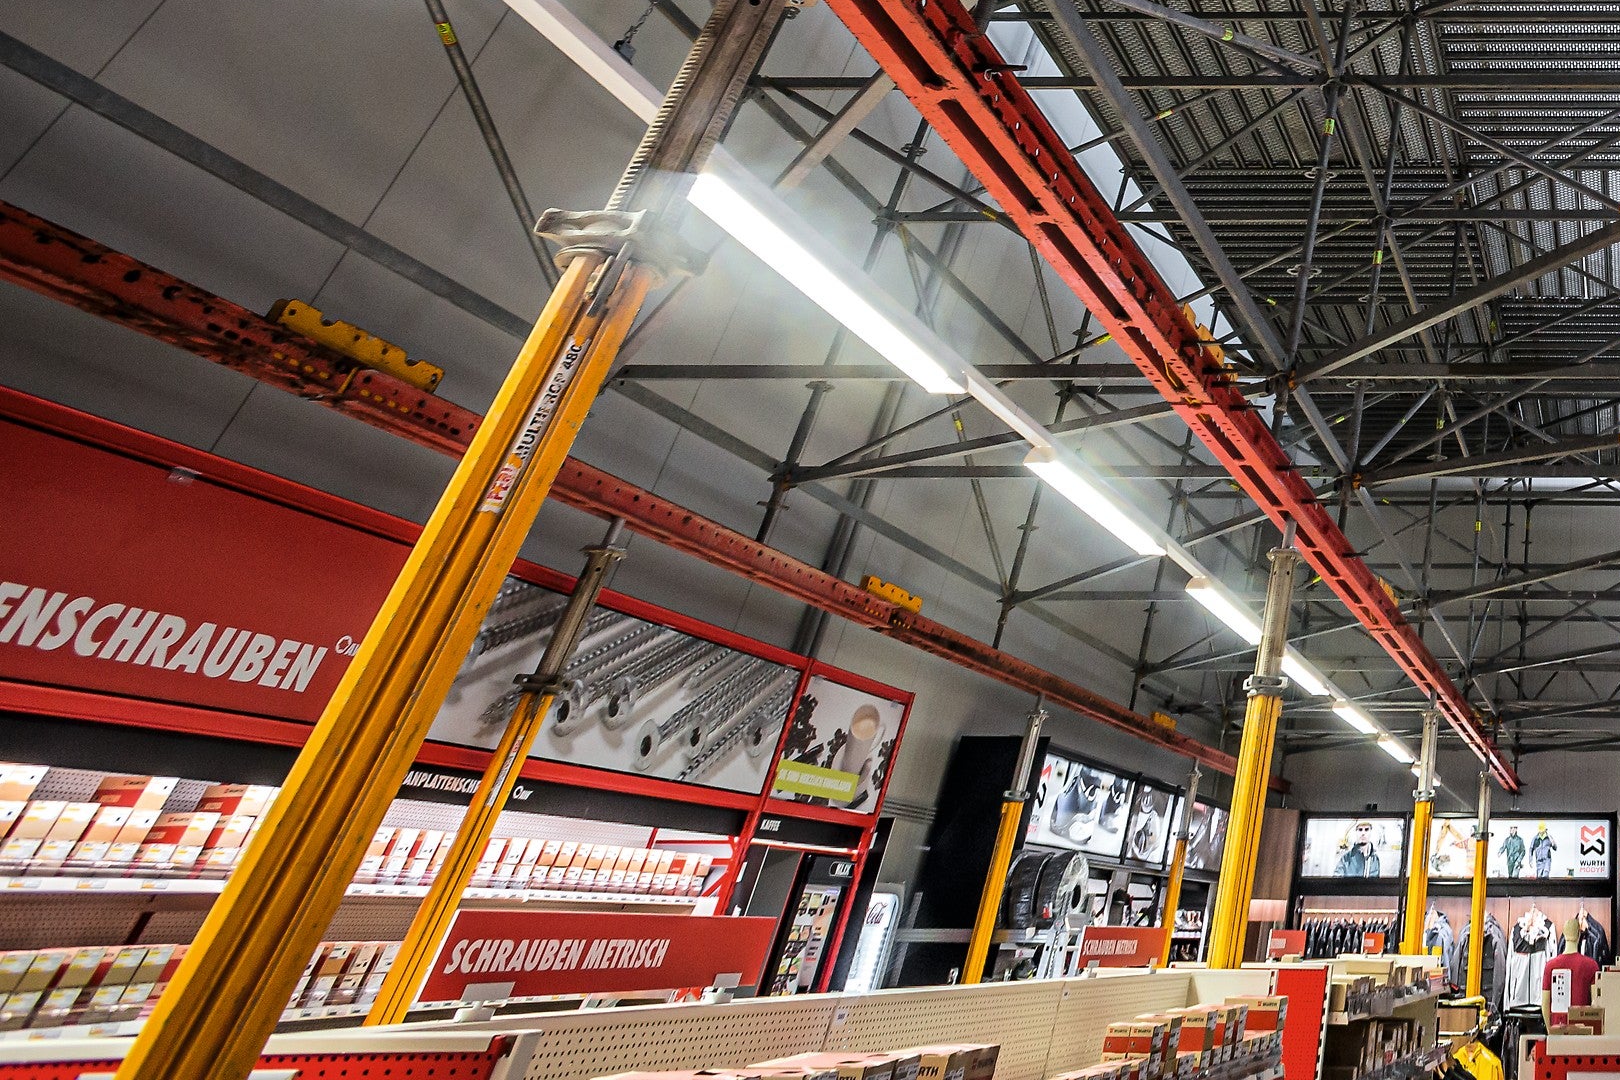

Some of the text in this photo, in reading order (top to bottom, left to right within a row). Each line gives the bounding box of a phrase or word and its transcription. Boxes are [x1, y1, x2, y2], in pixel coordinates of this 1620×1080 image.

[0, 582, 328, 692] ENSCHRAUBEN
[402, 770, 482, 794] ANPLATTENSCH
[443, 939, 671, 974] SCHRAUBEN METRISCH
